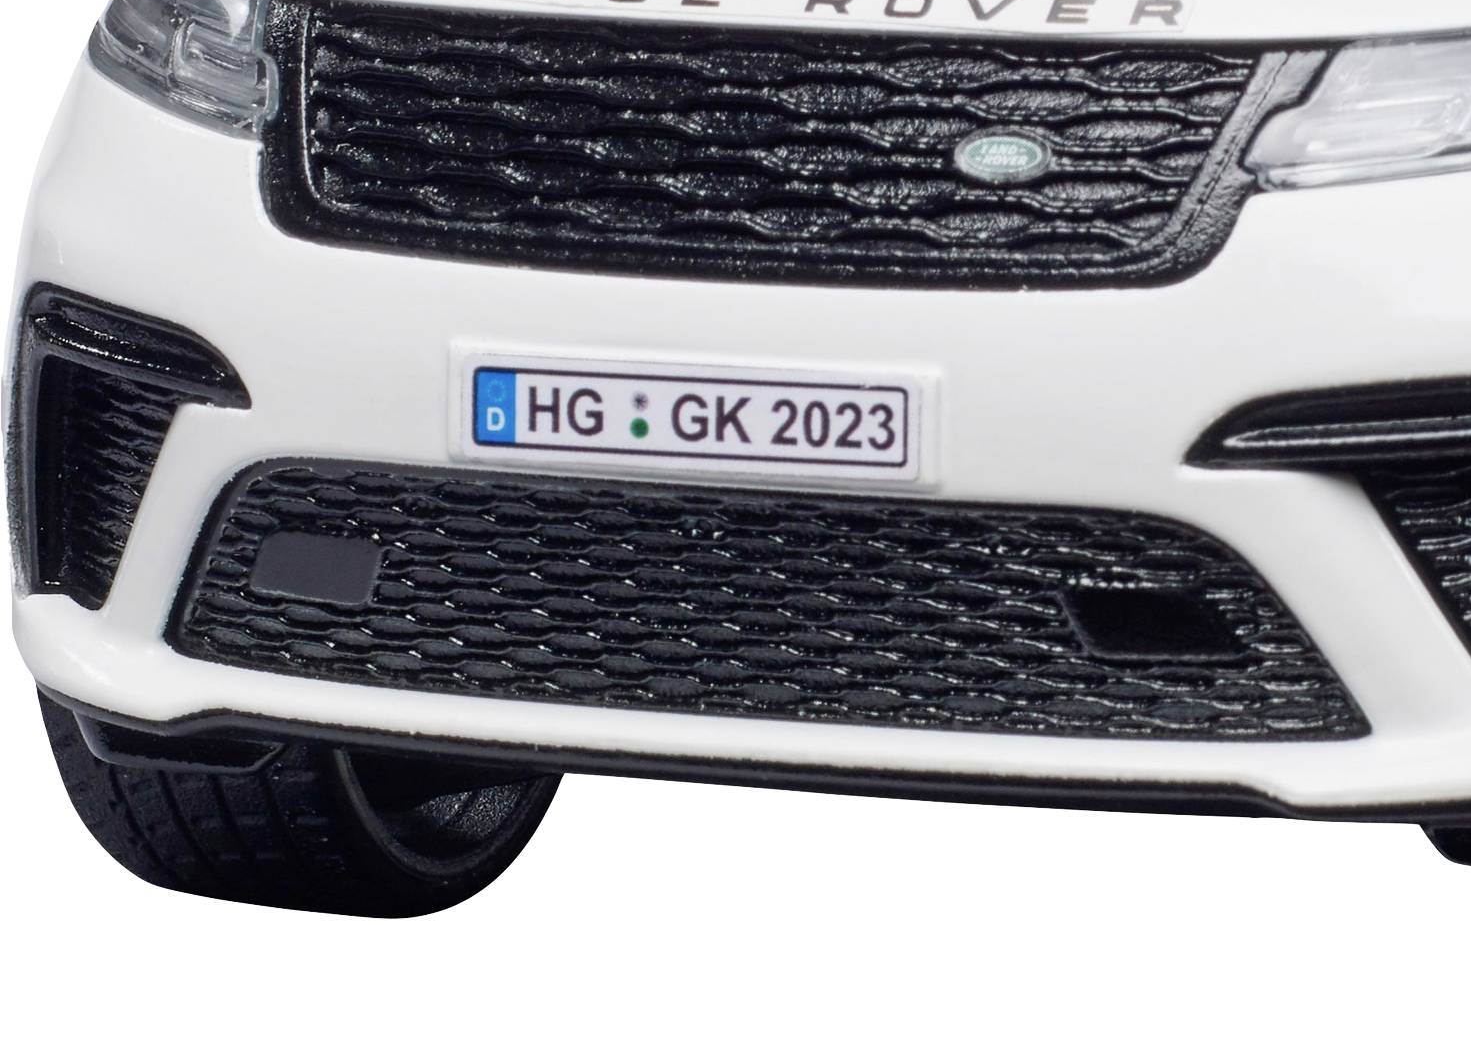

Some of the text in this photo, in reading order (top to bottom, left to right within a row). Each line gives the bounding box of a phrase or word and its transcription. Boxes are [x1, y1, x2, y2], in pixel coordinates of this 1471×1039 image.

[486, 406, 506, 431] D
[528, 385, 896, 451] HG GK 2023
